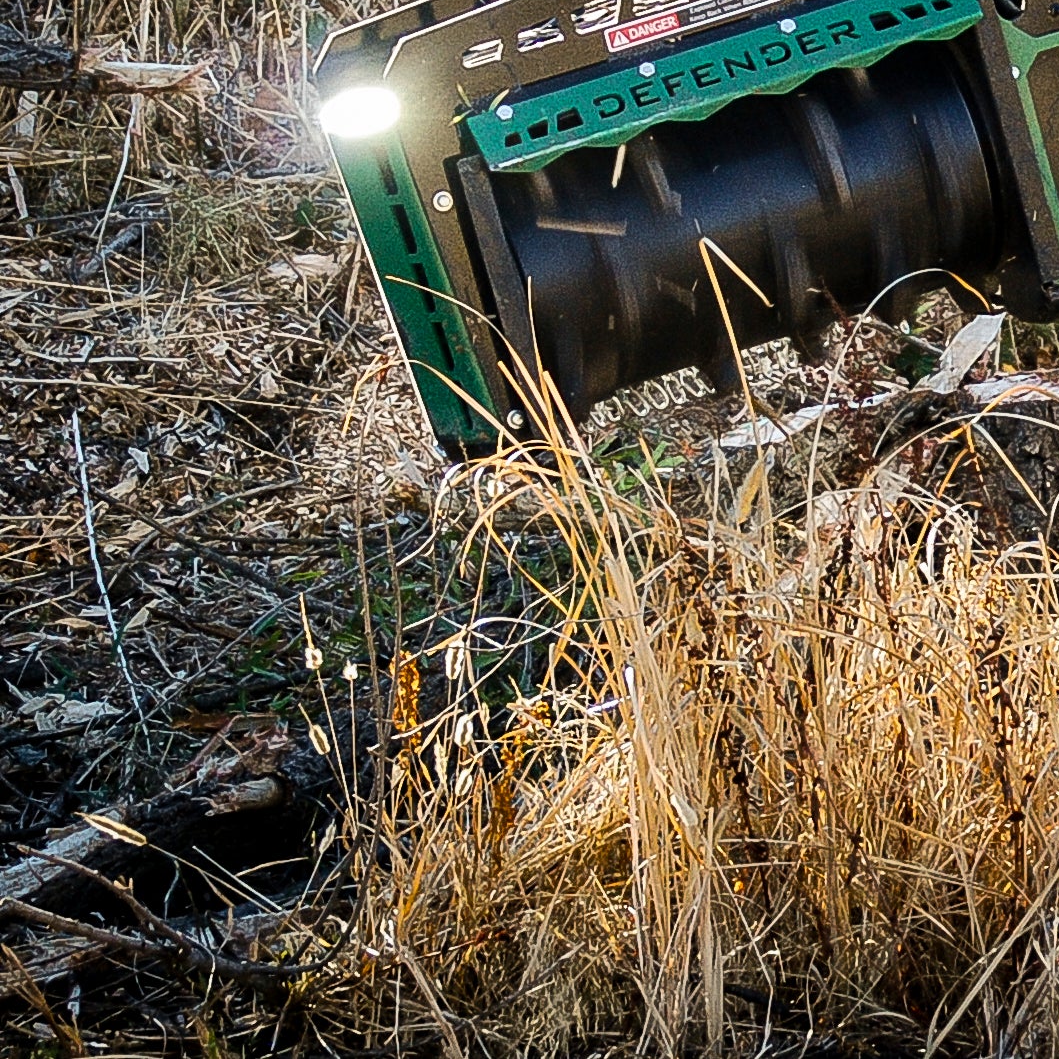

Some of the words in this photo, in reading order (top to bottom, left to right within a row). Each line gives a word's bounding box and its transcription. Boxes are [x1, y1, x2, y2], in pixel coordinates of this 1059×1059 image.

[689, 1, 717, 15] Exposed
[689, 13, 707, 22] Keep
[706, 7, 722, 17] Back
[722, 2, 743, 12] When
[628, 15, 678, 40] DANGER
[592, 19, 861, 120] DEFENDER
